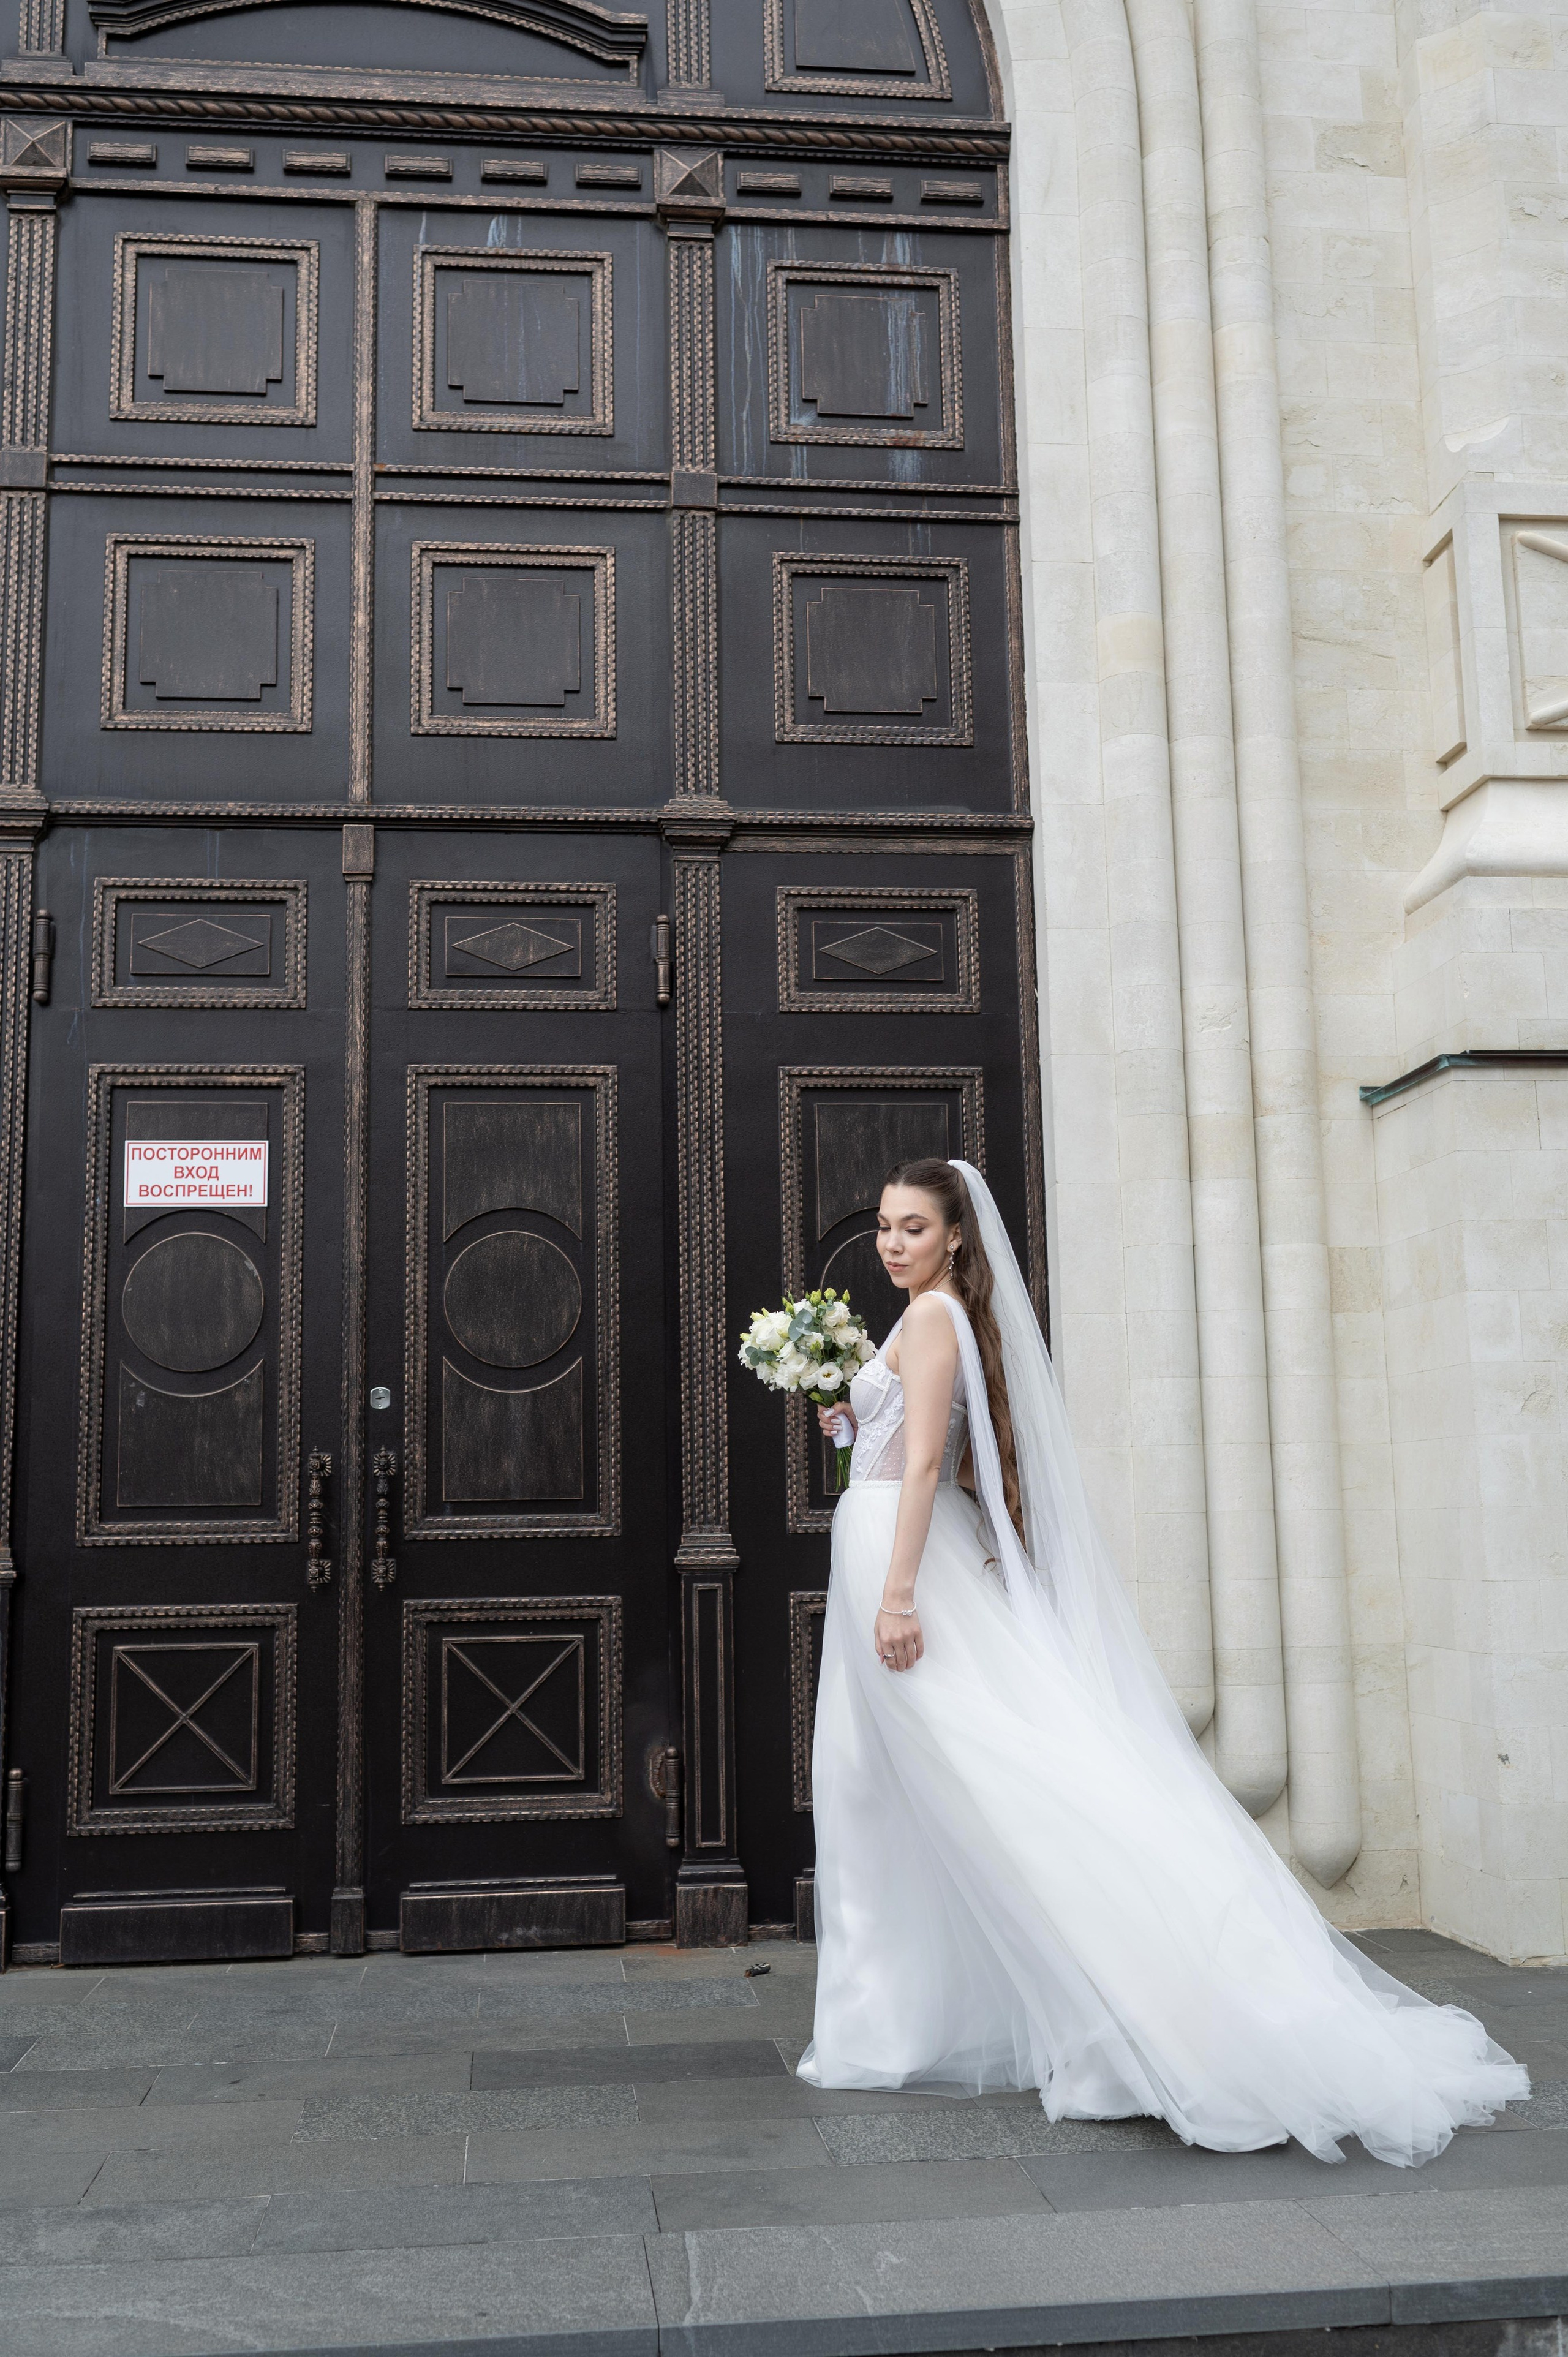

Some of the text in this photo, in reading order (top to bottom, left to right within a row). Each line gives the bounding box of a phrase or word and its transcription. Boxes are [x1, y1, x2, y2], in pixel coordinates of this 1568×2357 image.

[131, 1147, 262, 1161] ПОСТОРОННИМ
[174, 1166, 219, 1181] ВХОД
[138, 1184, 253, 1199] ВОСПРЕЩЕН!
